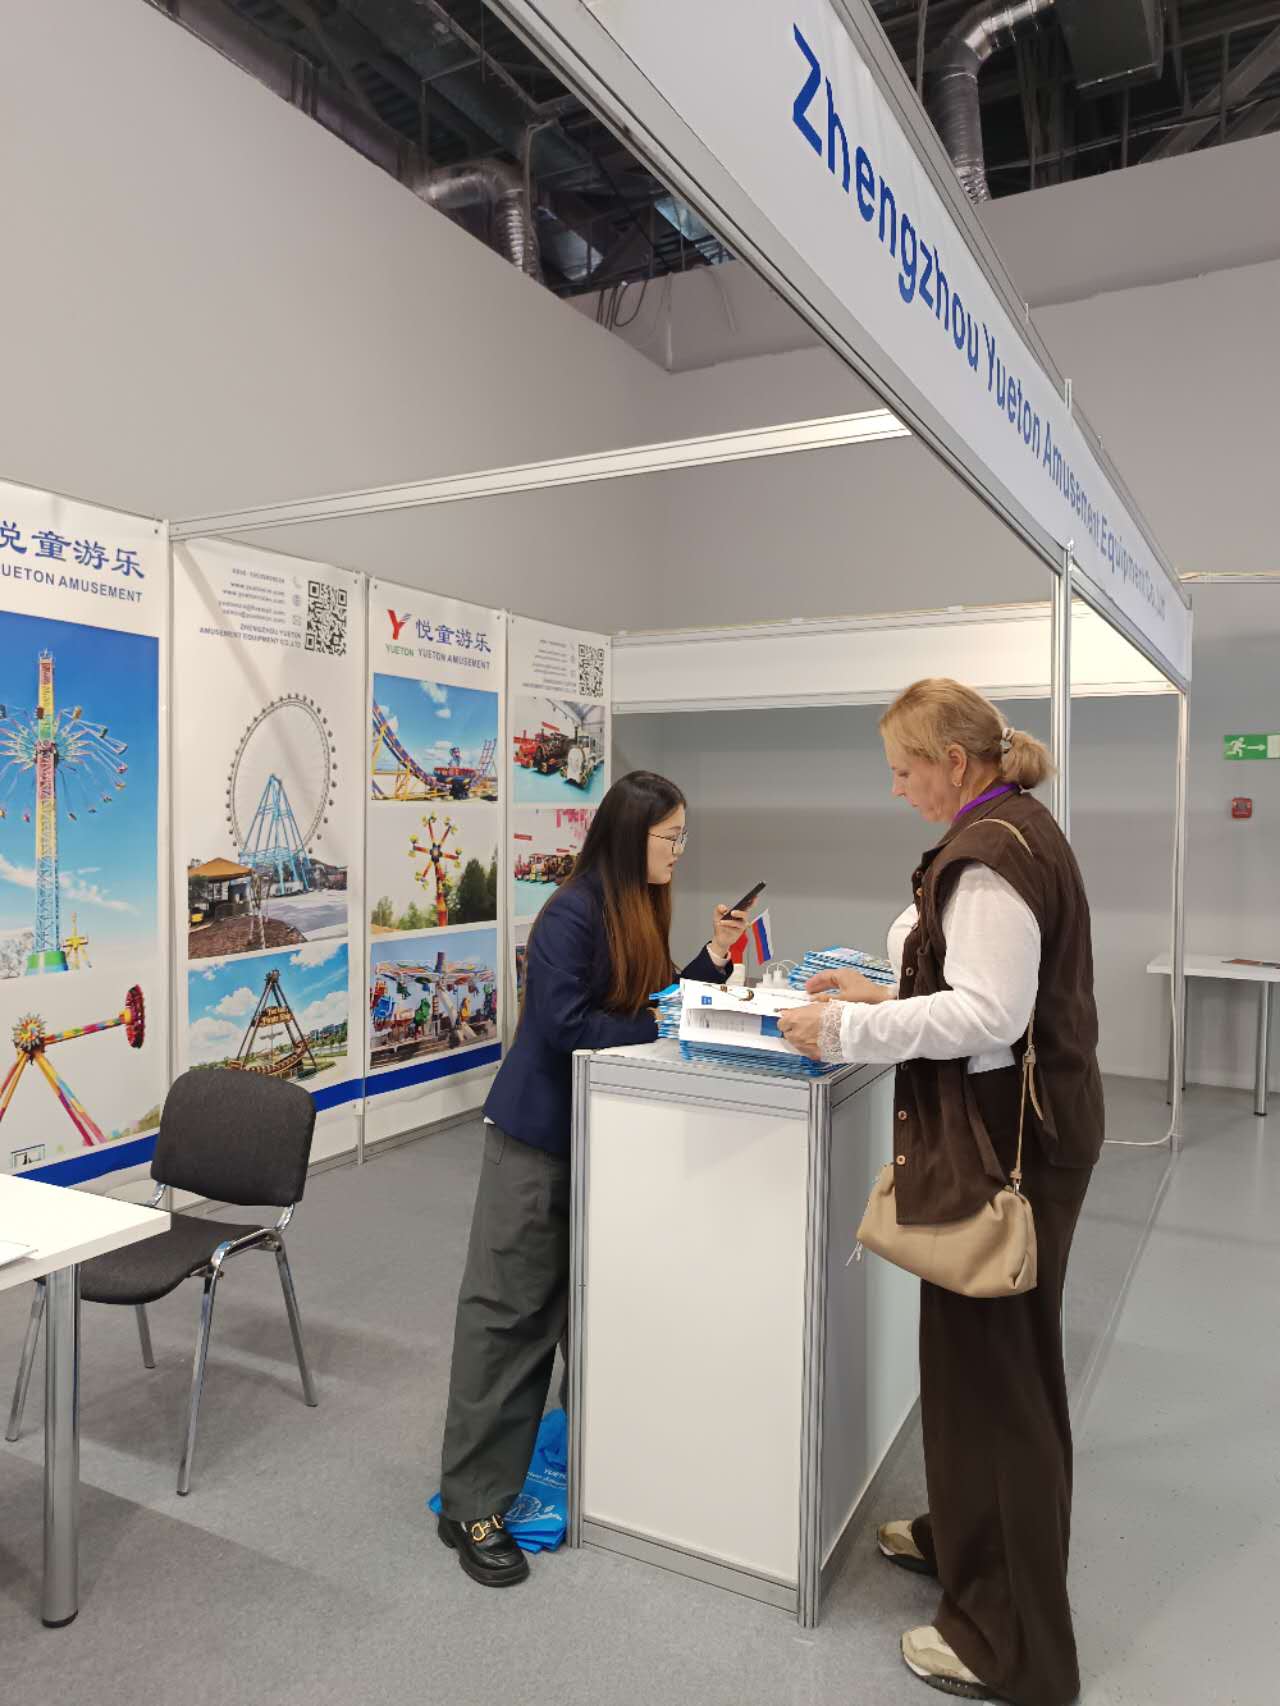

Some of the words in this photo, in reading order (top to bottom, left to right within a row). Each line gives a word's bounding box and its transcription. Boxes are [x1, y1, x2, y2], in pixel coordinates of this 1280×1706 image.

[793, 23, 979, 371] Zhengzhou
[983, 322, 1041, 459] Yueton
[1043, 421, 1100, 548] Amusement
[1, 564, 55, 585] UETON
[58, 575, 143, 602] AMUSEMENT
[385, 643, 414, 657] YUETON
[416, 618, 491, 653] 悦童游乐
[418, 648, 446, 661] YUETON
[447, 654, 491, 670] AMUSEMENT
